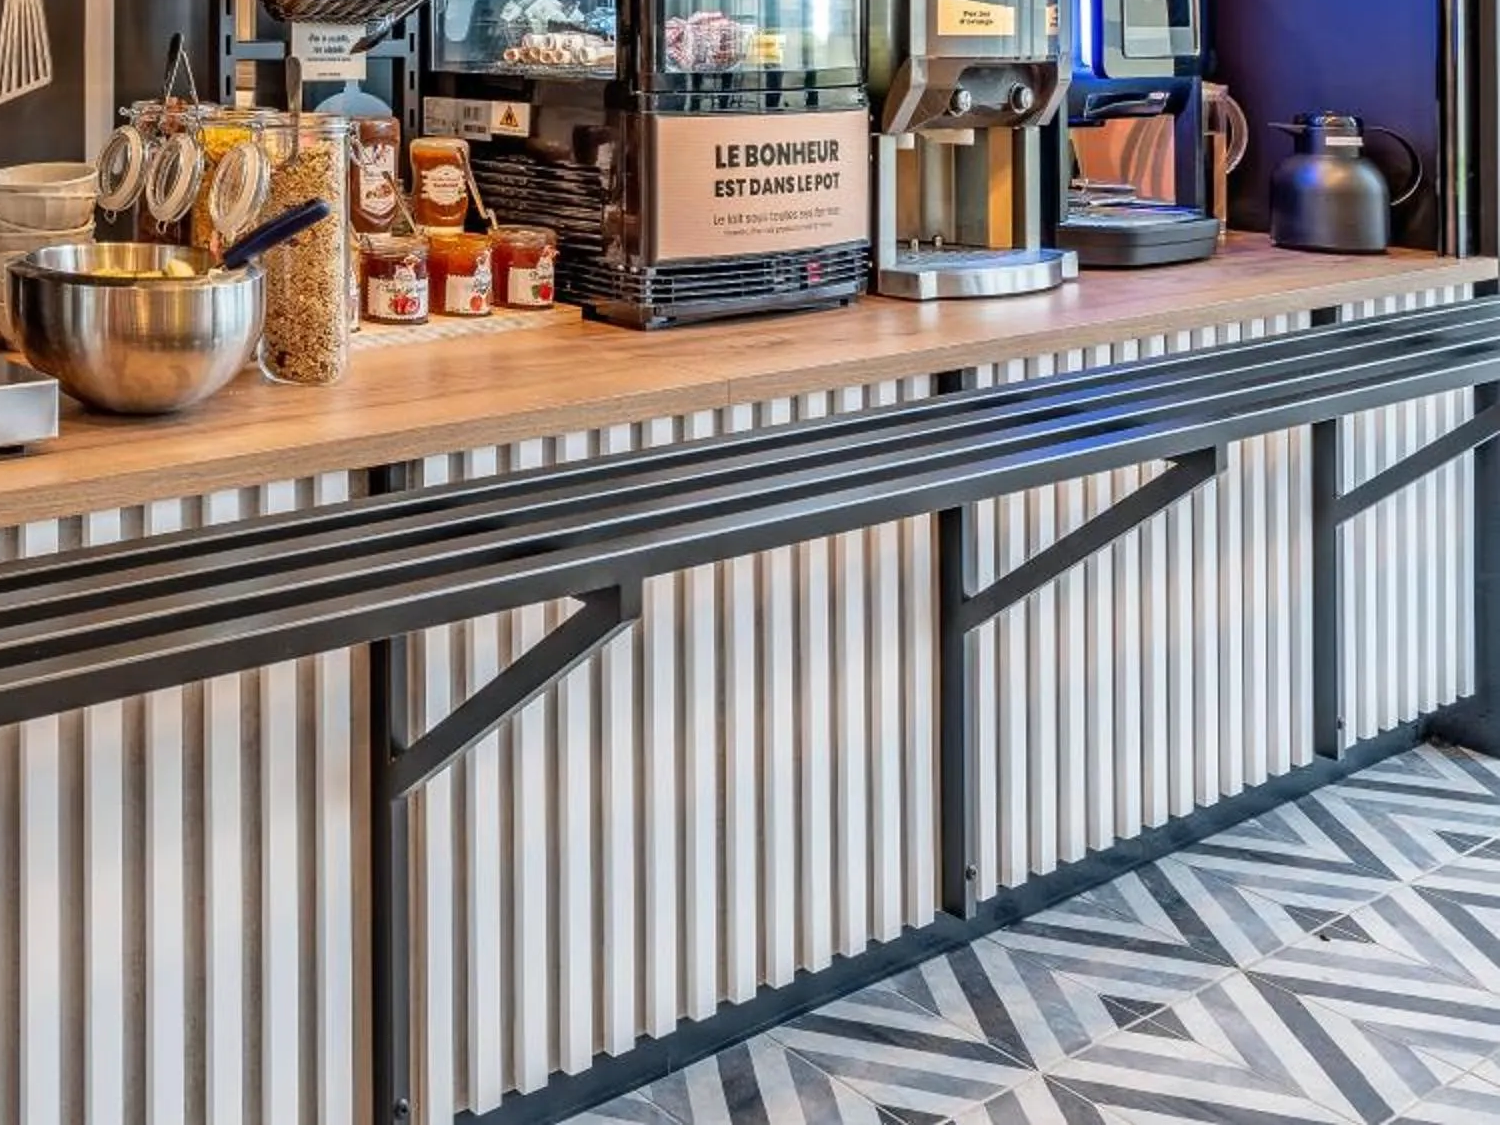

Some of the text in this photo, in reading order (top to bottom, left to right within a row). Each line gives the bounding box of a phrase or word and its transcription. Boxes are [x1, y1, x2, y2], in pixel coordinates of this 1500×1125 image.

[715, 139, 840, 169] LE BONHEUR
[714, 171, 840, 198] EST DANS LE POT
